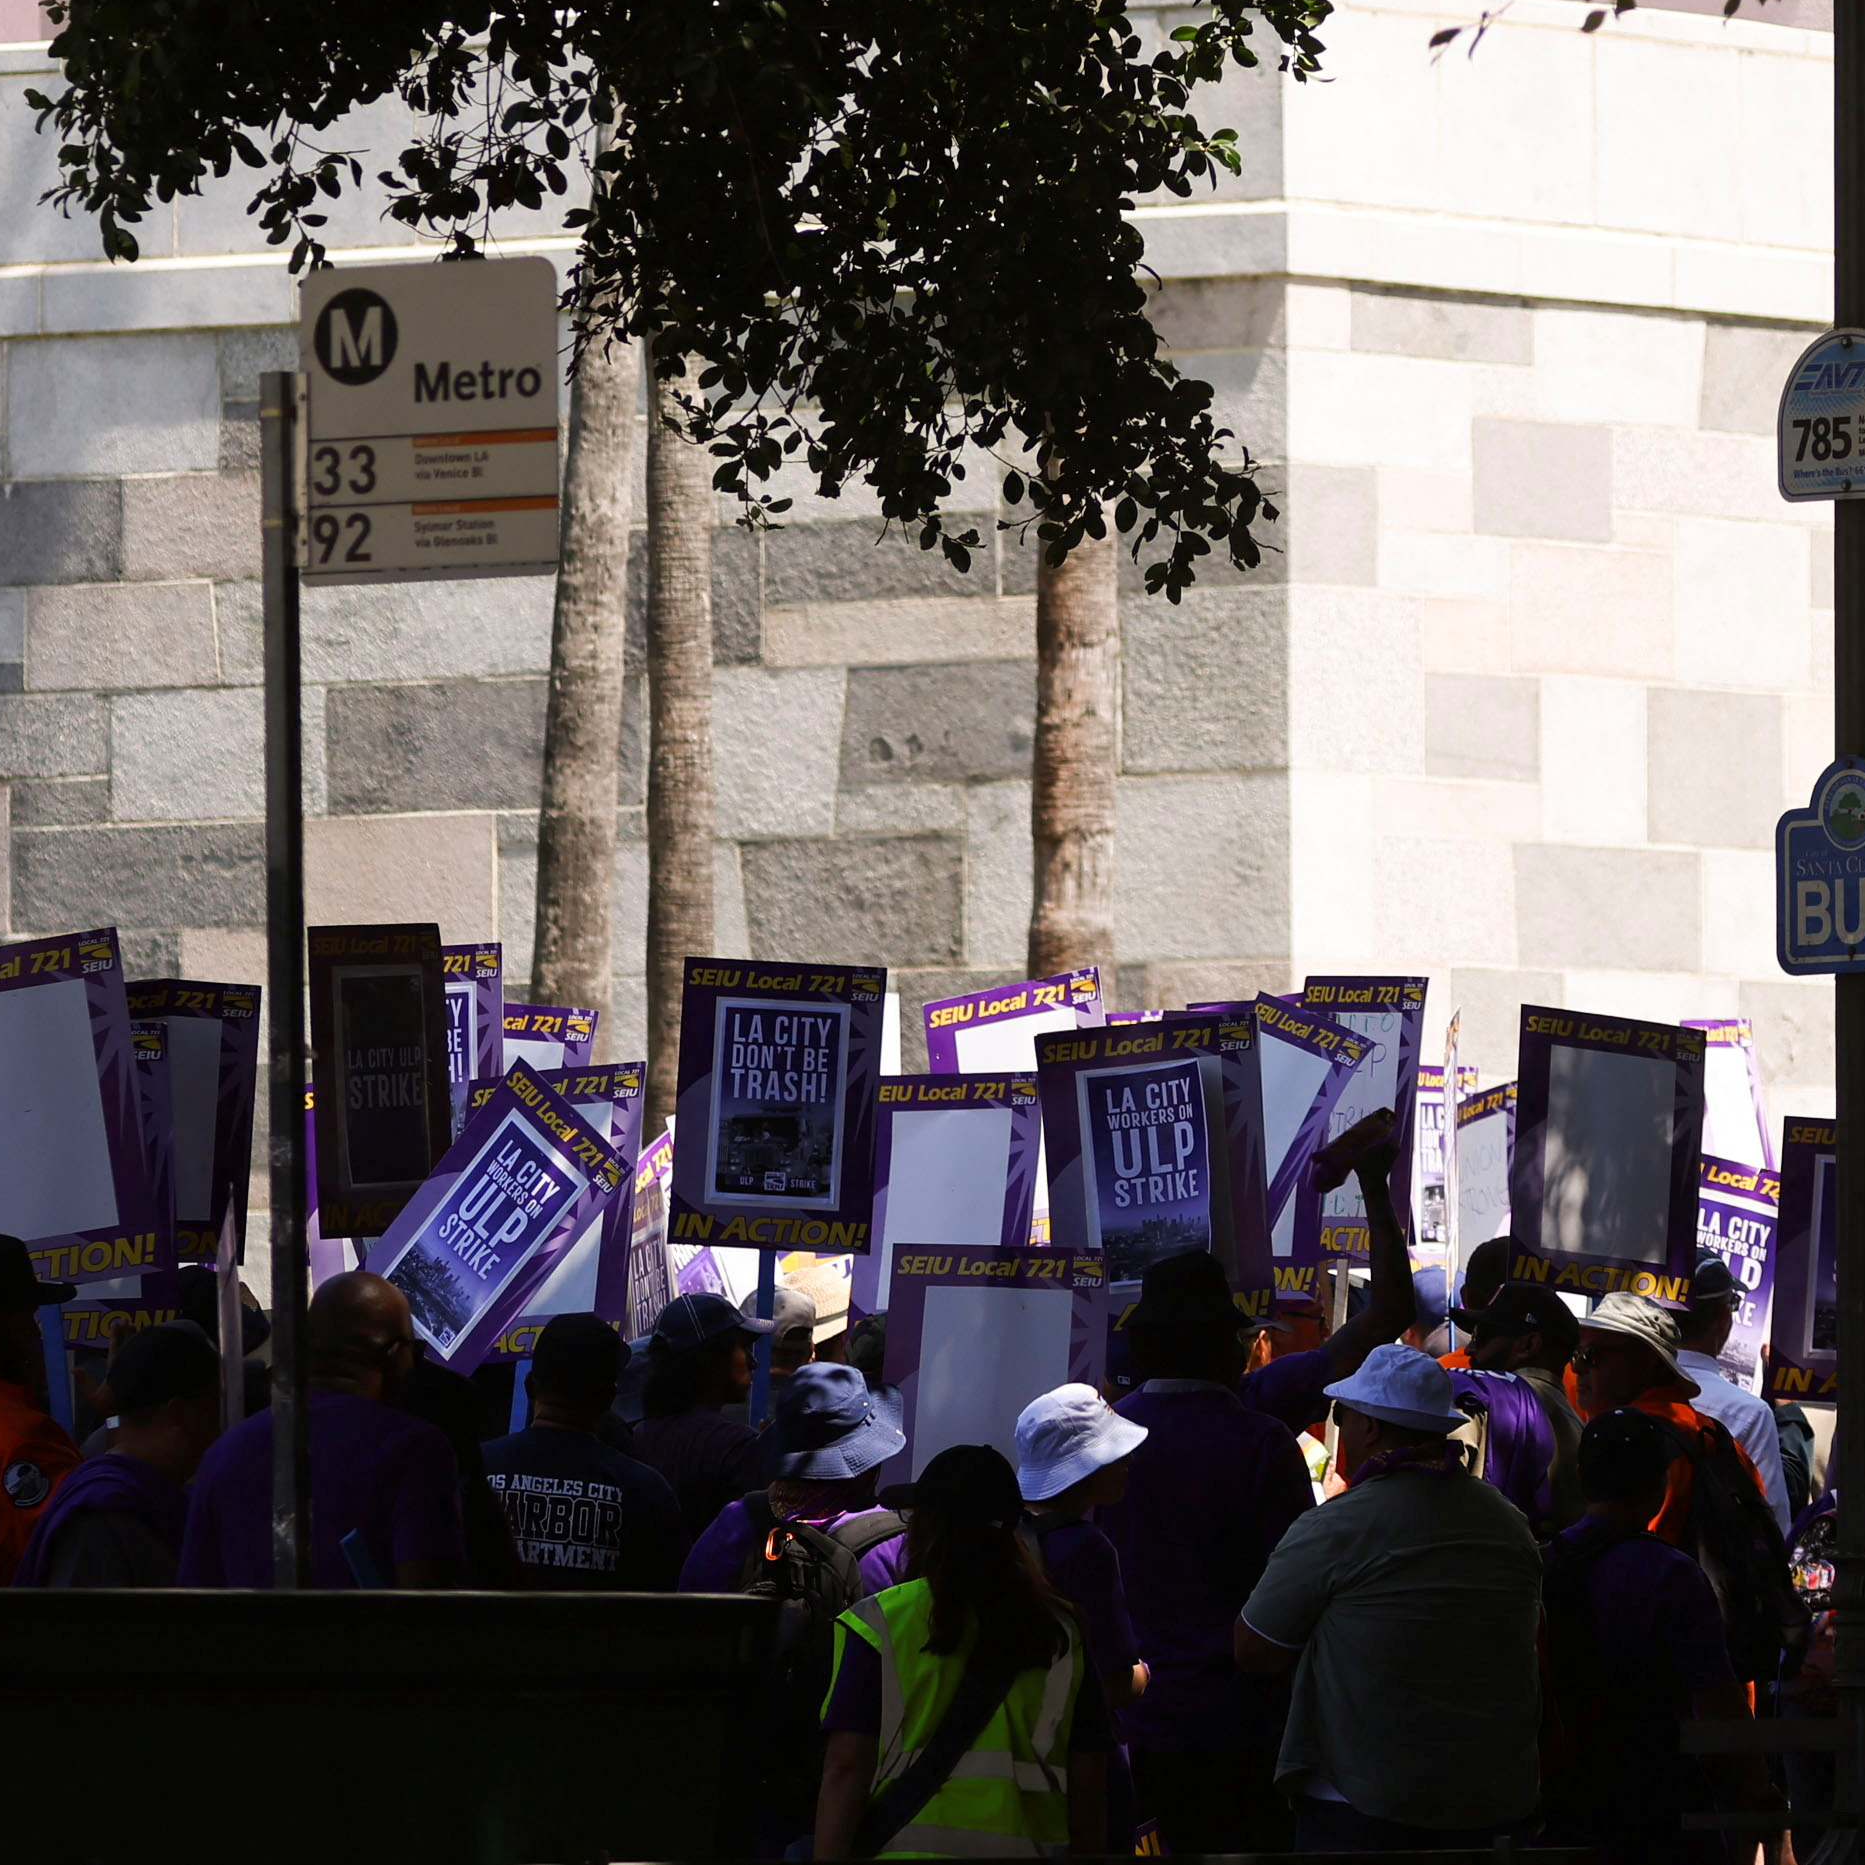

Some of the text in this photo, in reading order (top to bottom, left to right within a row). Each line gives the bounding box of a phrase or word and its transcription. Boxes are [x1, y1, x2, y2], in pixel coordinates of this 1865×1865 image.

[329, 306, 383, 369] M
[413, 361, 542, 404] Metro
[1793, 416, 1852, 462] 785
[314, 445, 377, 496] 33
[314, 513, 372, 564] 92
[29, 947, 73, 975] 721
[689, 968, 847, 994] SEIU Local 721
[734, 1013, 833, 1048] LA CITY
[1042, 1028, 1213, 1065] SEIU Local 721
[347, 1045, 423, 1070] LA CITY ULP
[731, 1042, 829, 1073] DON'T BE
[350, 1072, 425, 1111] STRIKE
[572, 1075, 609, 1096] 721
[730, 1067, 829, 1104] TRASH!
[878, 1081, 1006, 1104] EIU Local 721
[1105, 1077, 1192, 1115] LA CITY
[1106, 1103, 1194, 1131] WORKERS ON
[1110, 1121, 1195, 1180] ULP
[486, 1159, 544, 1220] WORKERS ON
[496, 1139, 561, 1206] LA CITY
[739, 1175, 817, 1190] ULP STRIKE
[1113, 1169, 1200, 1209] STRIKE
[458, 1176, 529, 1250] ULP
[672, 1212, 869, 1248] IN ACTION!
[1700, 1208, 1771, 1248] LA CITY
[438, 1213, 502, 1281] STRIKE
[1696, 1230, 1767, 1260] WORKERS ON
[1512, 1254, 1552, 1281] IN
[1555, 1261, 1692, 1303] ACTION!
[1772, 1366, 1805, 1392] IN
[510, 1474, 584, 1497] ANGELES
[587, 1482, 624, 1503] CITY
[504, 1490, 623, 1549] ARBOR
